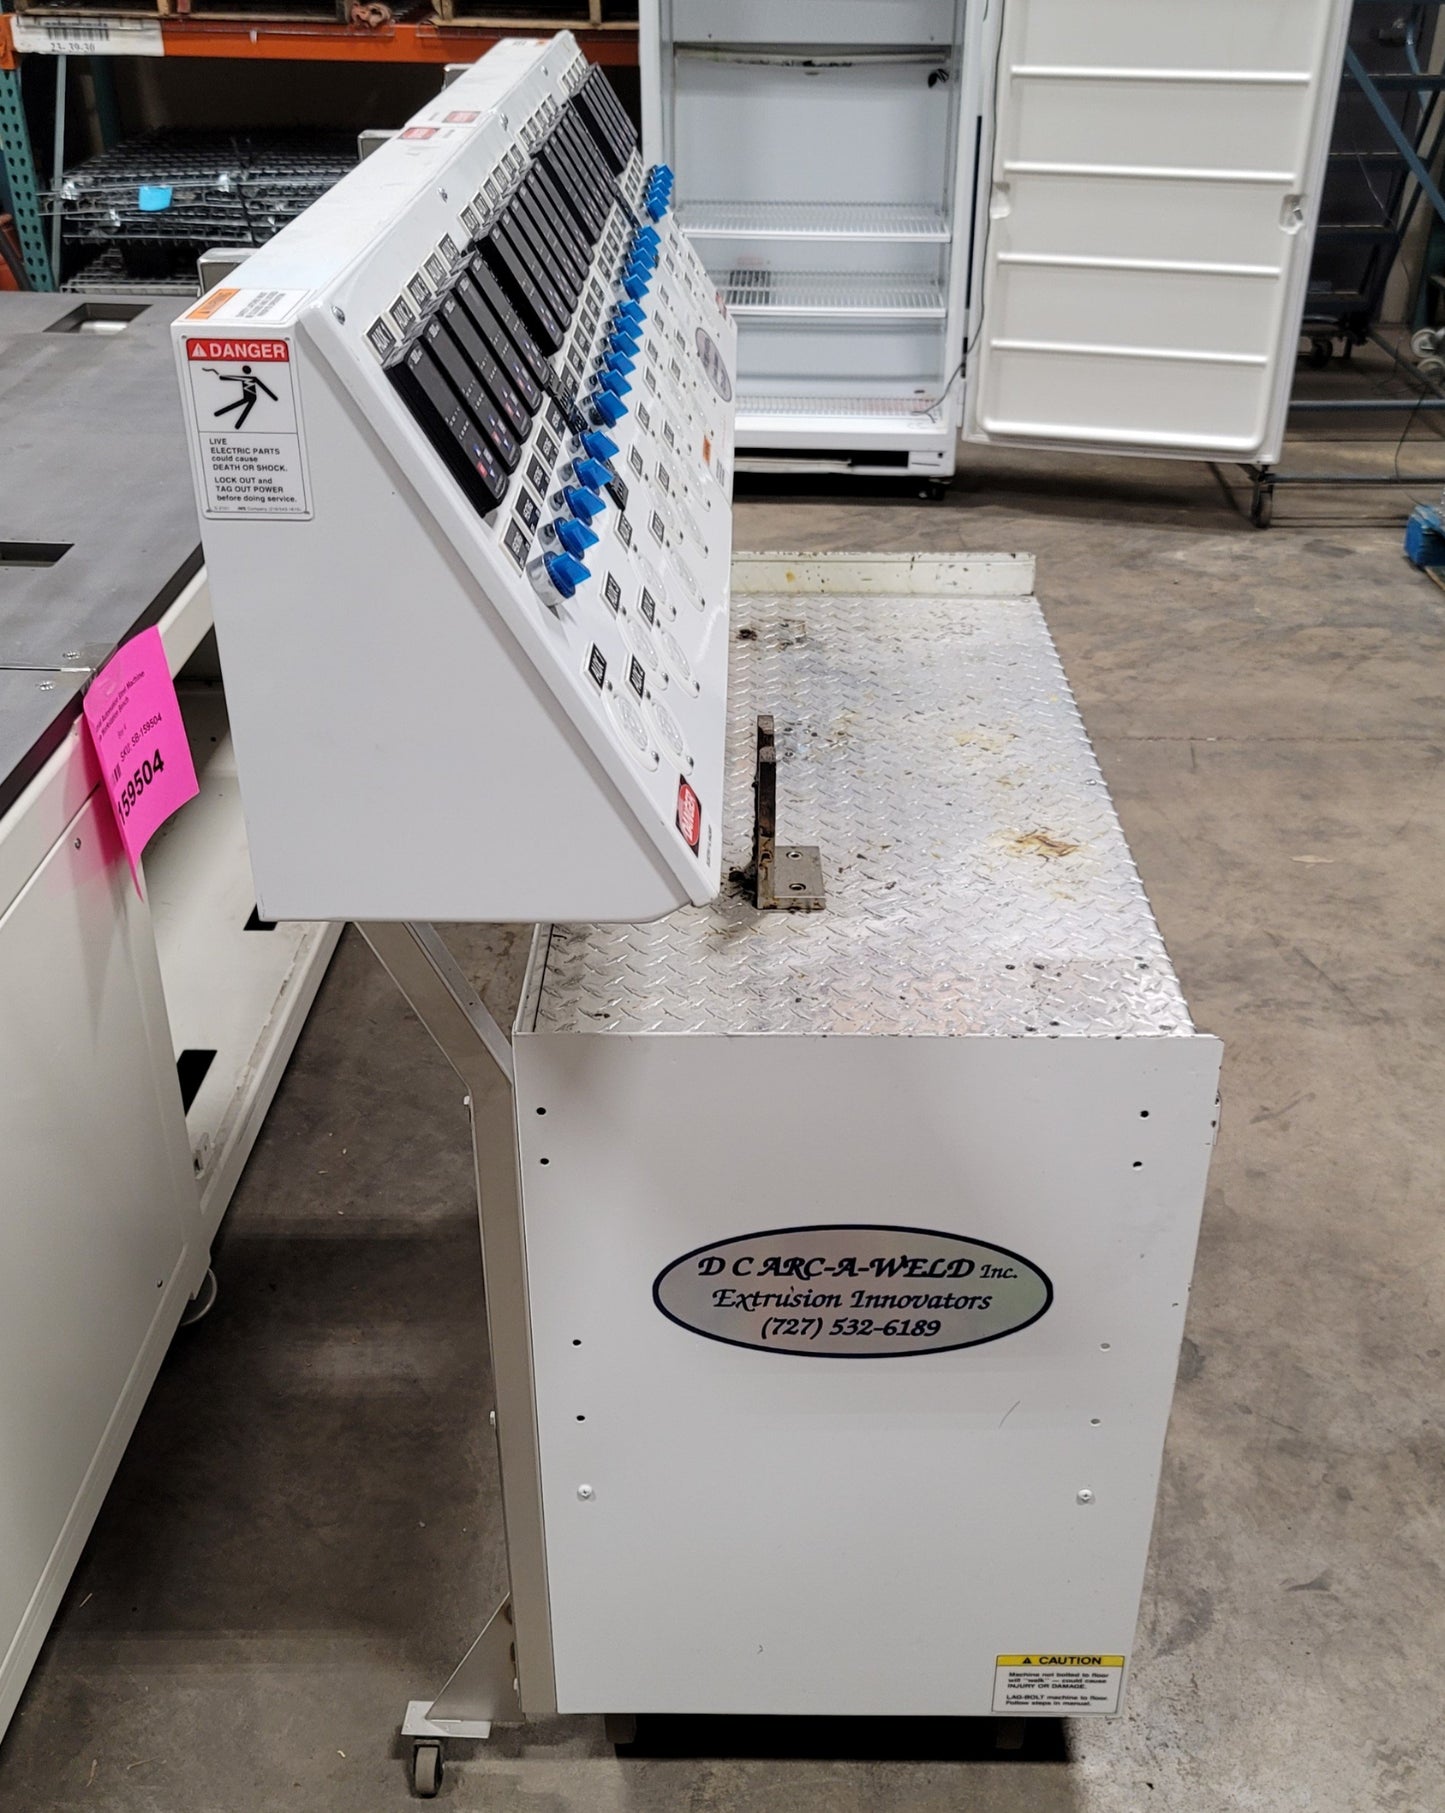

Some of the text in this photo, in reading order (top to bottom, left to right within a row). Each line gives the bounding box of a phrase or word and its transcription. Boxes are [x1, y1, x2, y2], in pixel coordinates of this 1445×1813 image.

[209, 343, 286, 358] DANGER
[243, 495, 266, 503] doing
[131, 712, 162, 748] SB-159504
[118, 748, 165, 827] 159504
[698, 1255, 1018, 1281] D C ARC-A-WELD Inc.
[712, 1287, 993, 1312] Extrusion Innovators
[761, 1316, 942, 1340] (727) 532-6189
[1039, 1656, 1102, 1665] CAUTION
